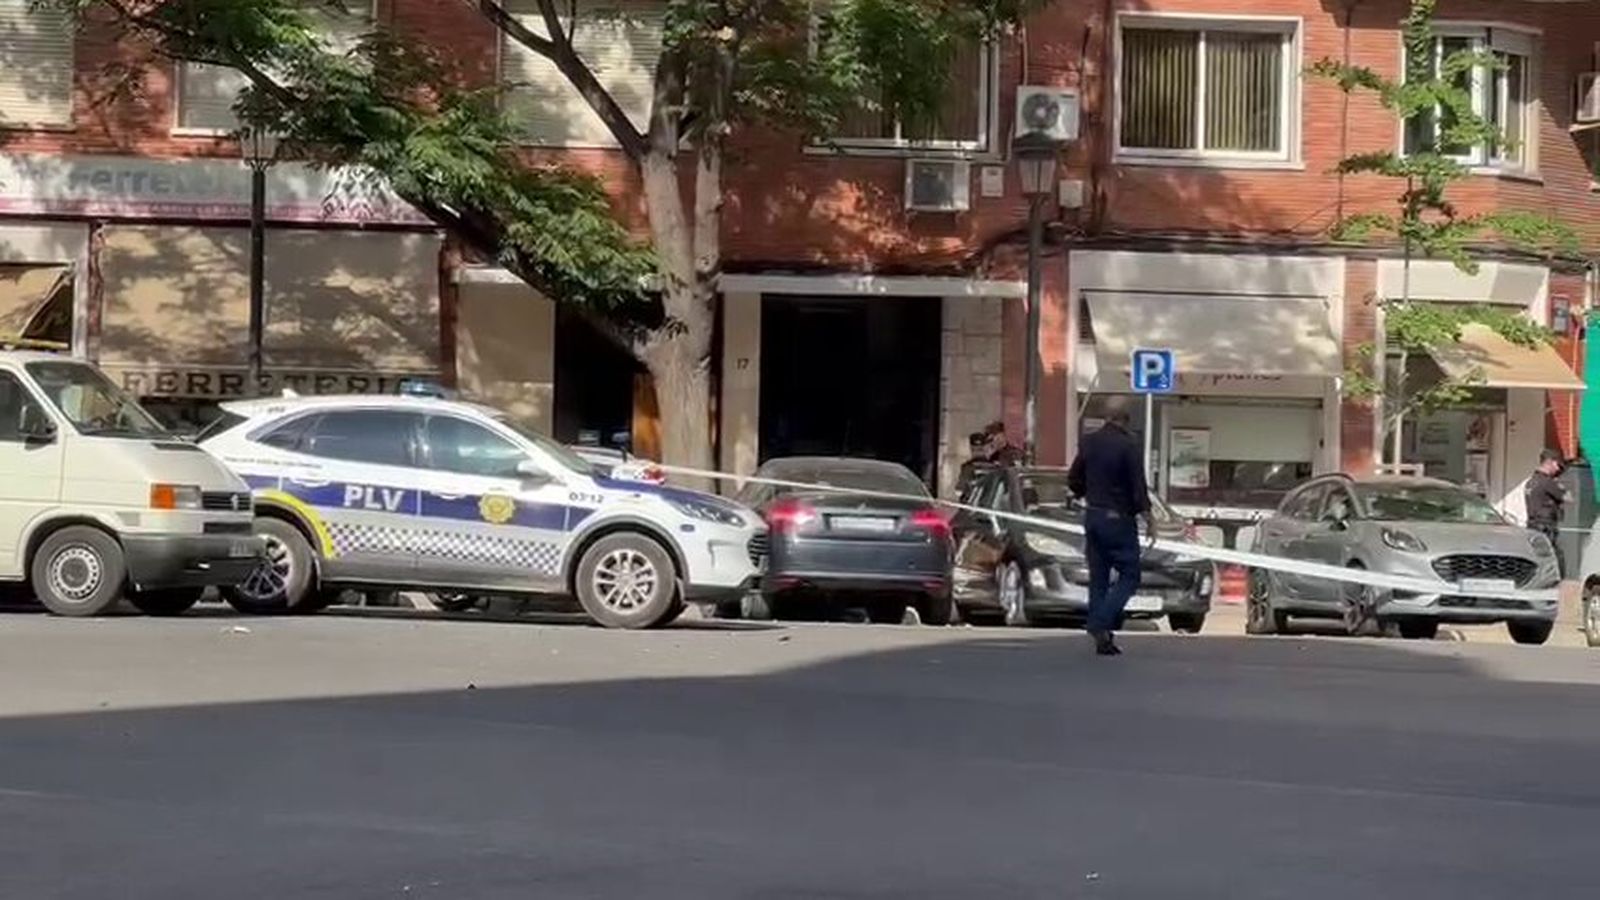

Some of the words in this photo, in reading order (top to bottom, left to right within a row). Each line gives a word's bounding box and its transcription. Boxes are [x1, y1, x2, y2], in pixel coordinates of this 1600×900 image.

[736, 357, 750, 370] 17
[1139, 353, 1166, 388] P
[343, 484, 405, 511] PLV
